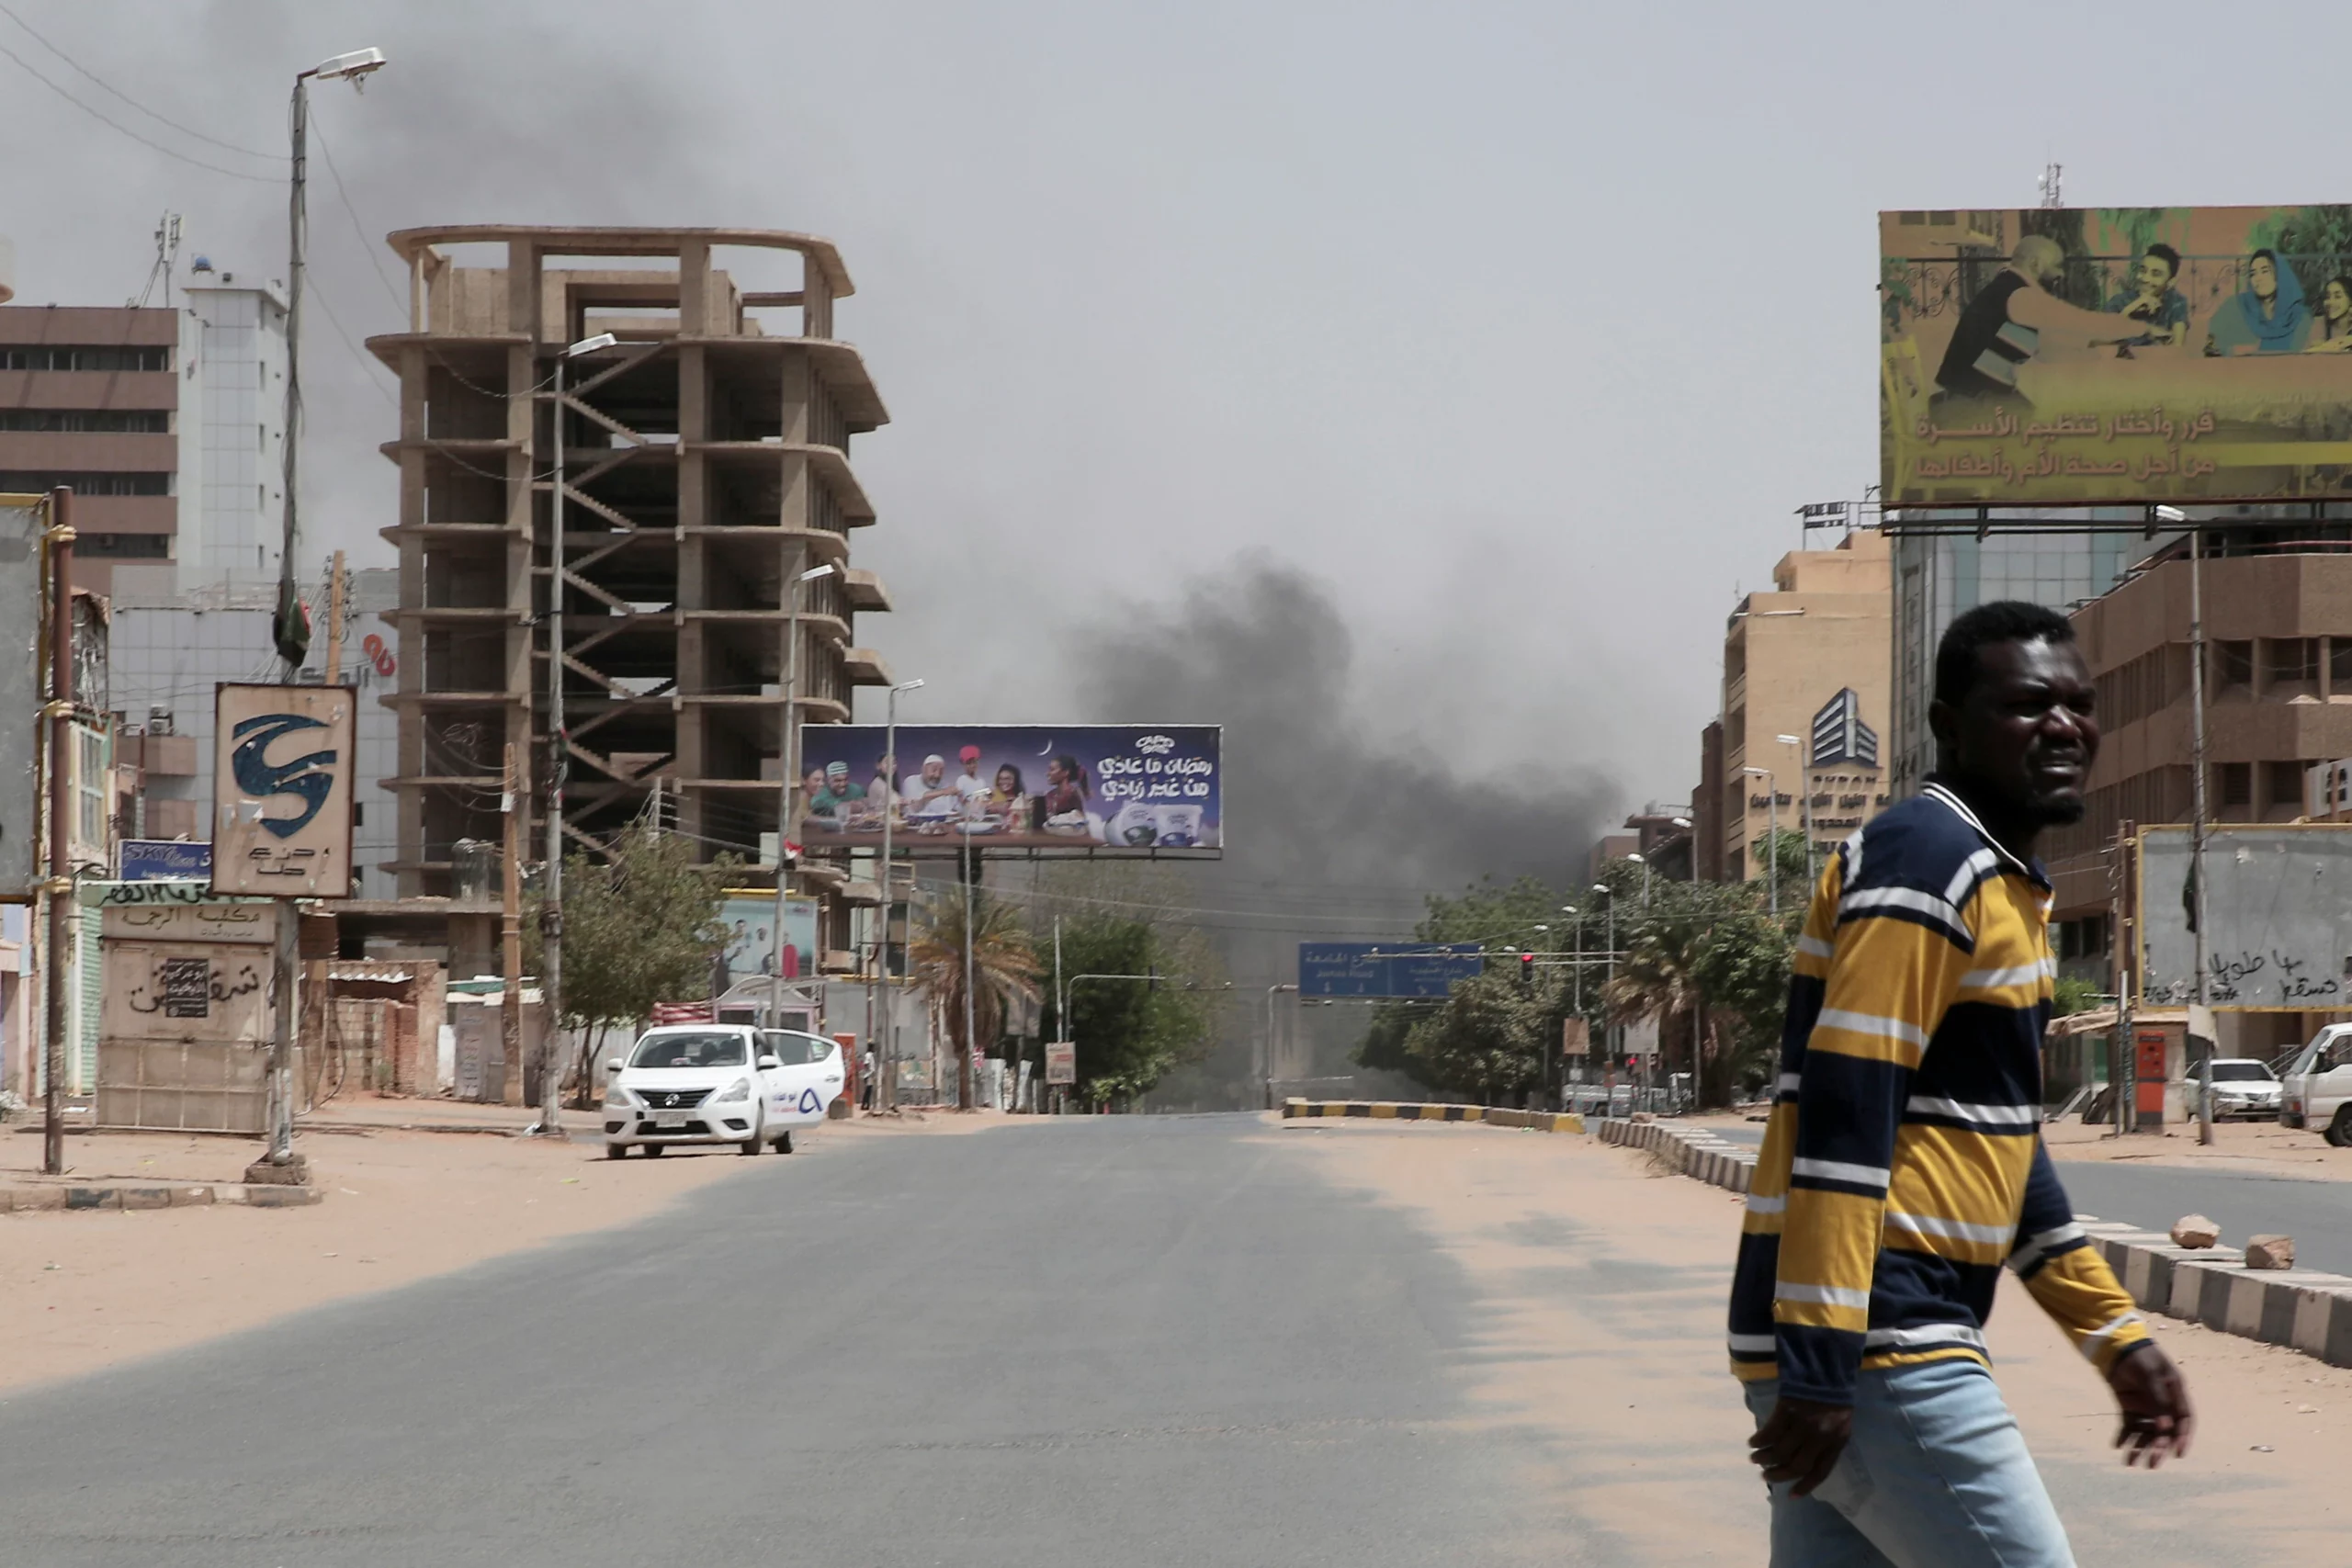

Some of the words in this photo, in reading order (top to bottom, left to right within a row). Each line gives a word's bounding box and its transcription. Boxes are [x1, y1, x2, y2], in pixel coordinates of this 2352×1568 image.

[2023, 413, 2098, 446] تنظيم
[2105, 407, 2174, 443] وأختار
[2181, 411, 2215, 441] قرر
[1916, 447, 2014, 483] وأطفالها
[2018, 446, 2060, 483] الأم
[2066, 454, 2127, 475] صحة
[2132, 444, 2179, 481] أجل
[2182, 456, 2216, 479] من
